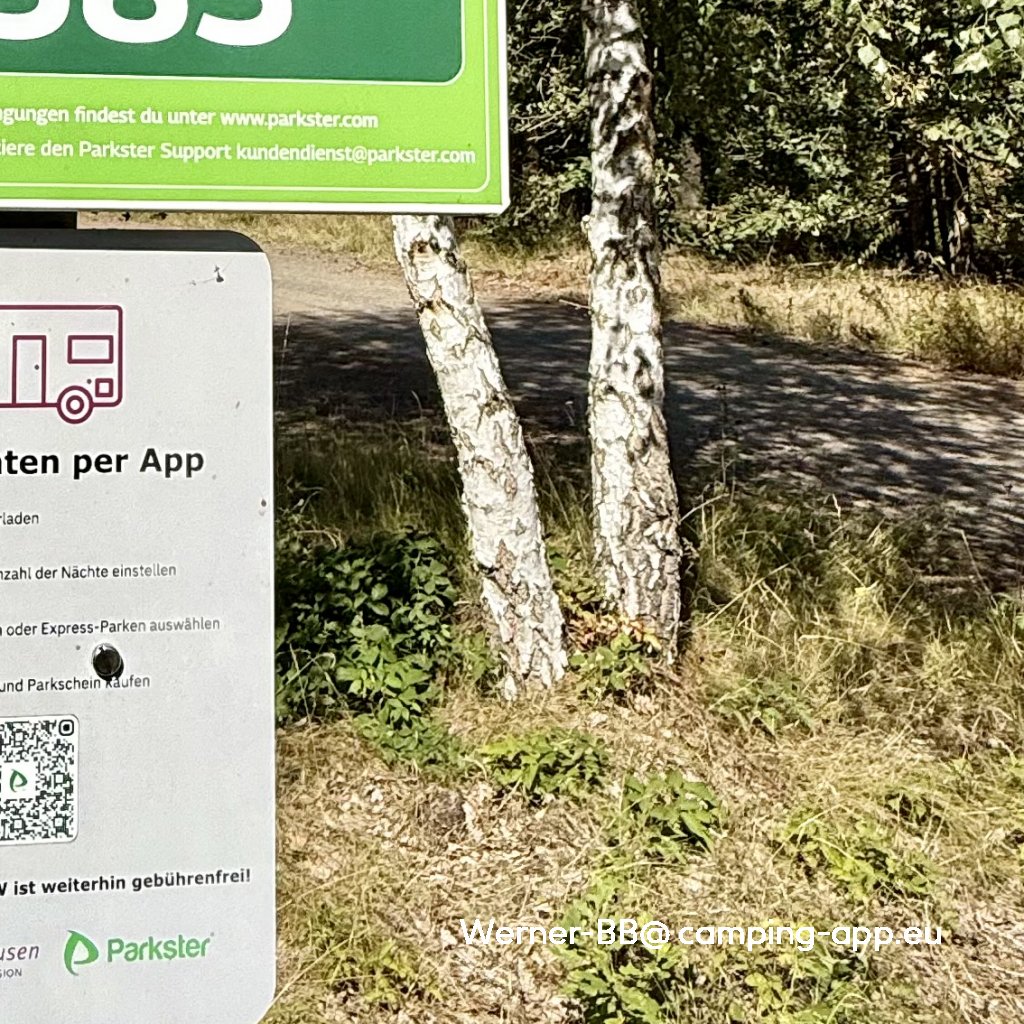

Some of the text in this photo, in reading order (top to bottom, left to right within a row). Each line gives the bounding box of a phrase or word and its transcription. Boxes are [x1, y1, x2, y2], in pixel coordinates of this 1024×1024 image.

[75, 106, 136, 124] findest
[140, 106, 163, 124] du
[167, 110, 216, 125] unter
[220, 110, 379, 130] www.parkster.com
[40, 139, 74, 157] den
[79, 140, 155, 159] Parkster
[160, 142, 232, 164] Support
[236, 143, 476, 166] kundendienst@parkster.com
[73, 453, 128, 480] per
[139, 447, 204, 478] App
[35, 566, 57, 580] der
[61, 564, 109, 579] Nächte
[112, 563, 177, 578] einstellen
[6, 622, 38, 637] oder
[41, 619, 146, 638] Express-Parken
[149, 617, 220, 632] auswählen
[27, 676, 101, 692] Parkschein
[13, 880, 36, 896] ist
[41, 875, 126, 894] weiterhin
[132, 868, 251, 892] gebührenfrei!
[107, 934, 210, 963] Parkster
